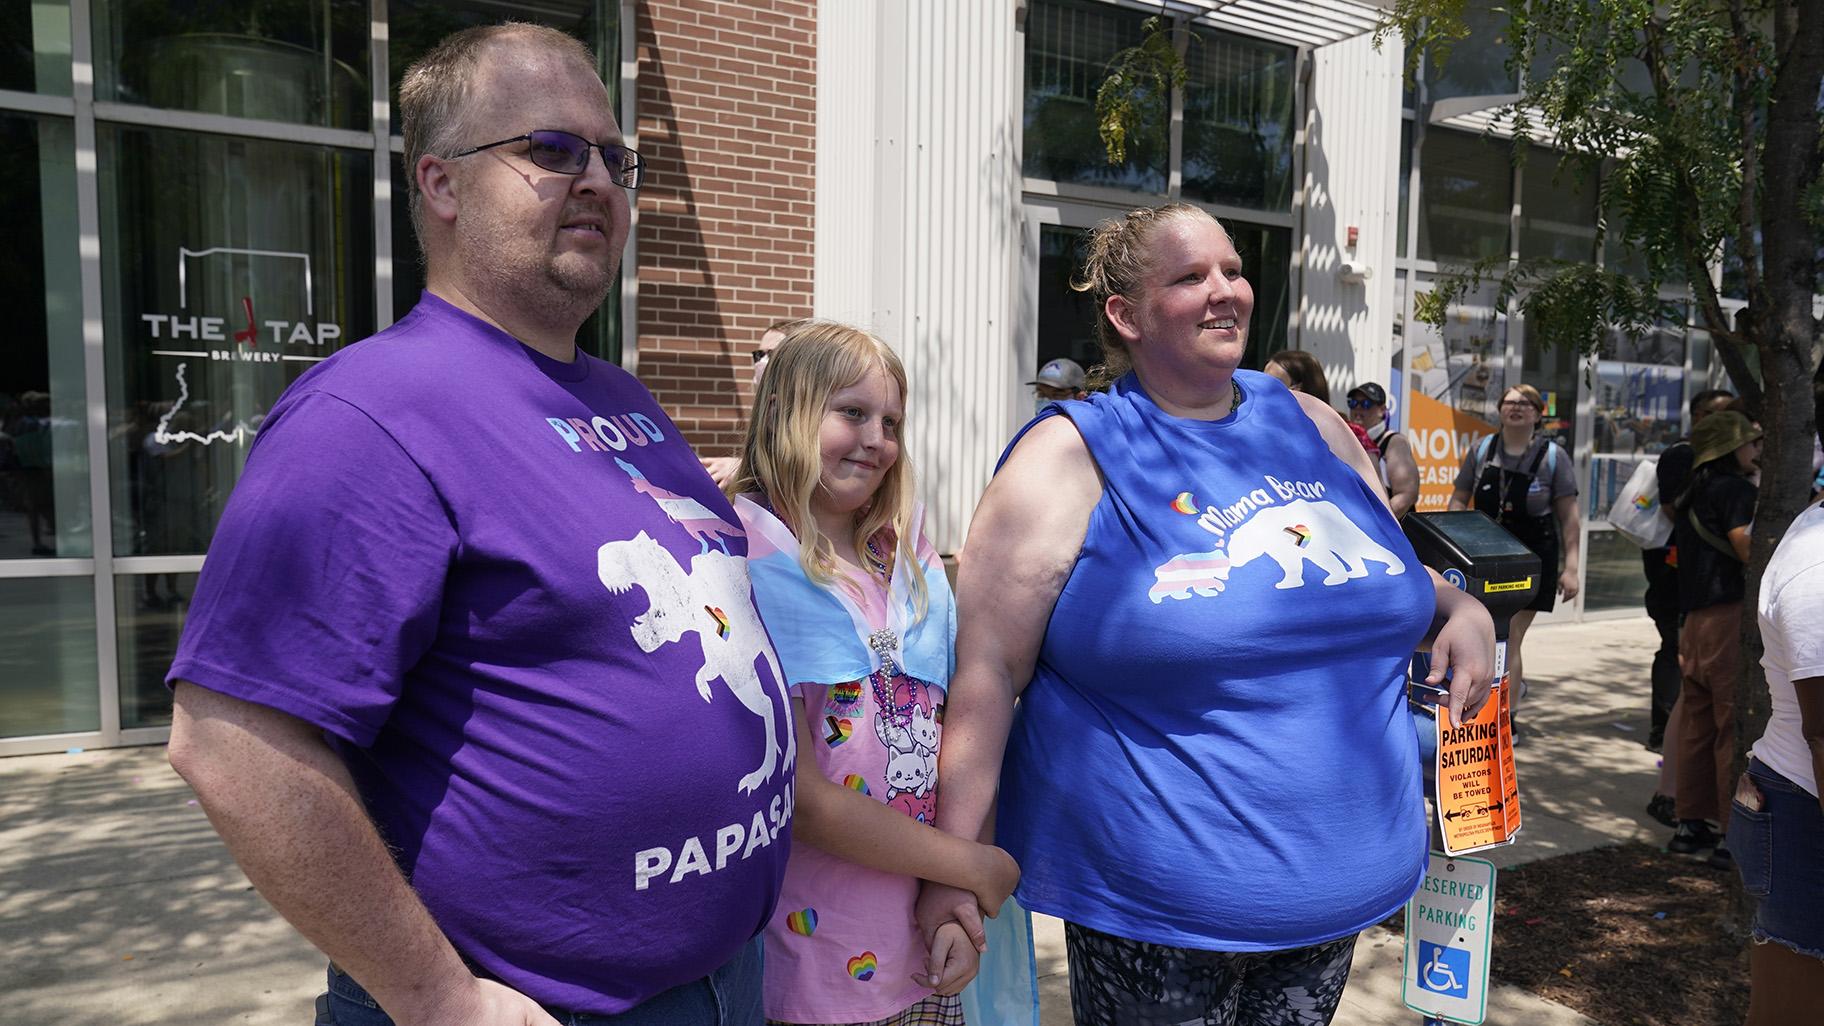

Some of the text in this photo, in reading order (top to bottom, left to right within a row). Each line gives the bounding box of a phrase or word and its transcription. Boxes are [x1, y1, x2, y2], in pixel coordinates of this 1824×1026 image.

[142, 314, 341, 345] THE TAP
[545, 412, 665, 453] PROUD
[1197, 475, 1326, 537] Mama Bear
[1442, 722, 1497, 746] PARKING
[1441, 744, 1497, 769] SATURDAY
[1450, 769, 1492, 782] VIOLATORS
[1462, 780, 1480, 788] WILL
[1453, 787, 1491, 800] BE TOWED
[635, 774, 795, 890] PAPASA
[1420, 875, 1483, 900] ESERVED
[1419, 904, 1476, 931] PARKING
